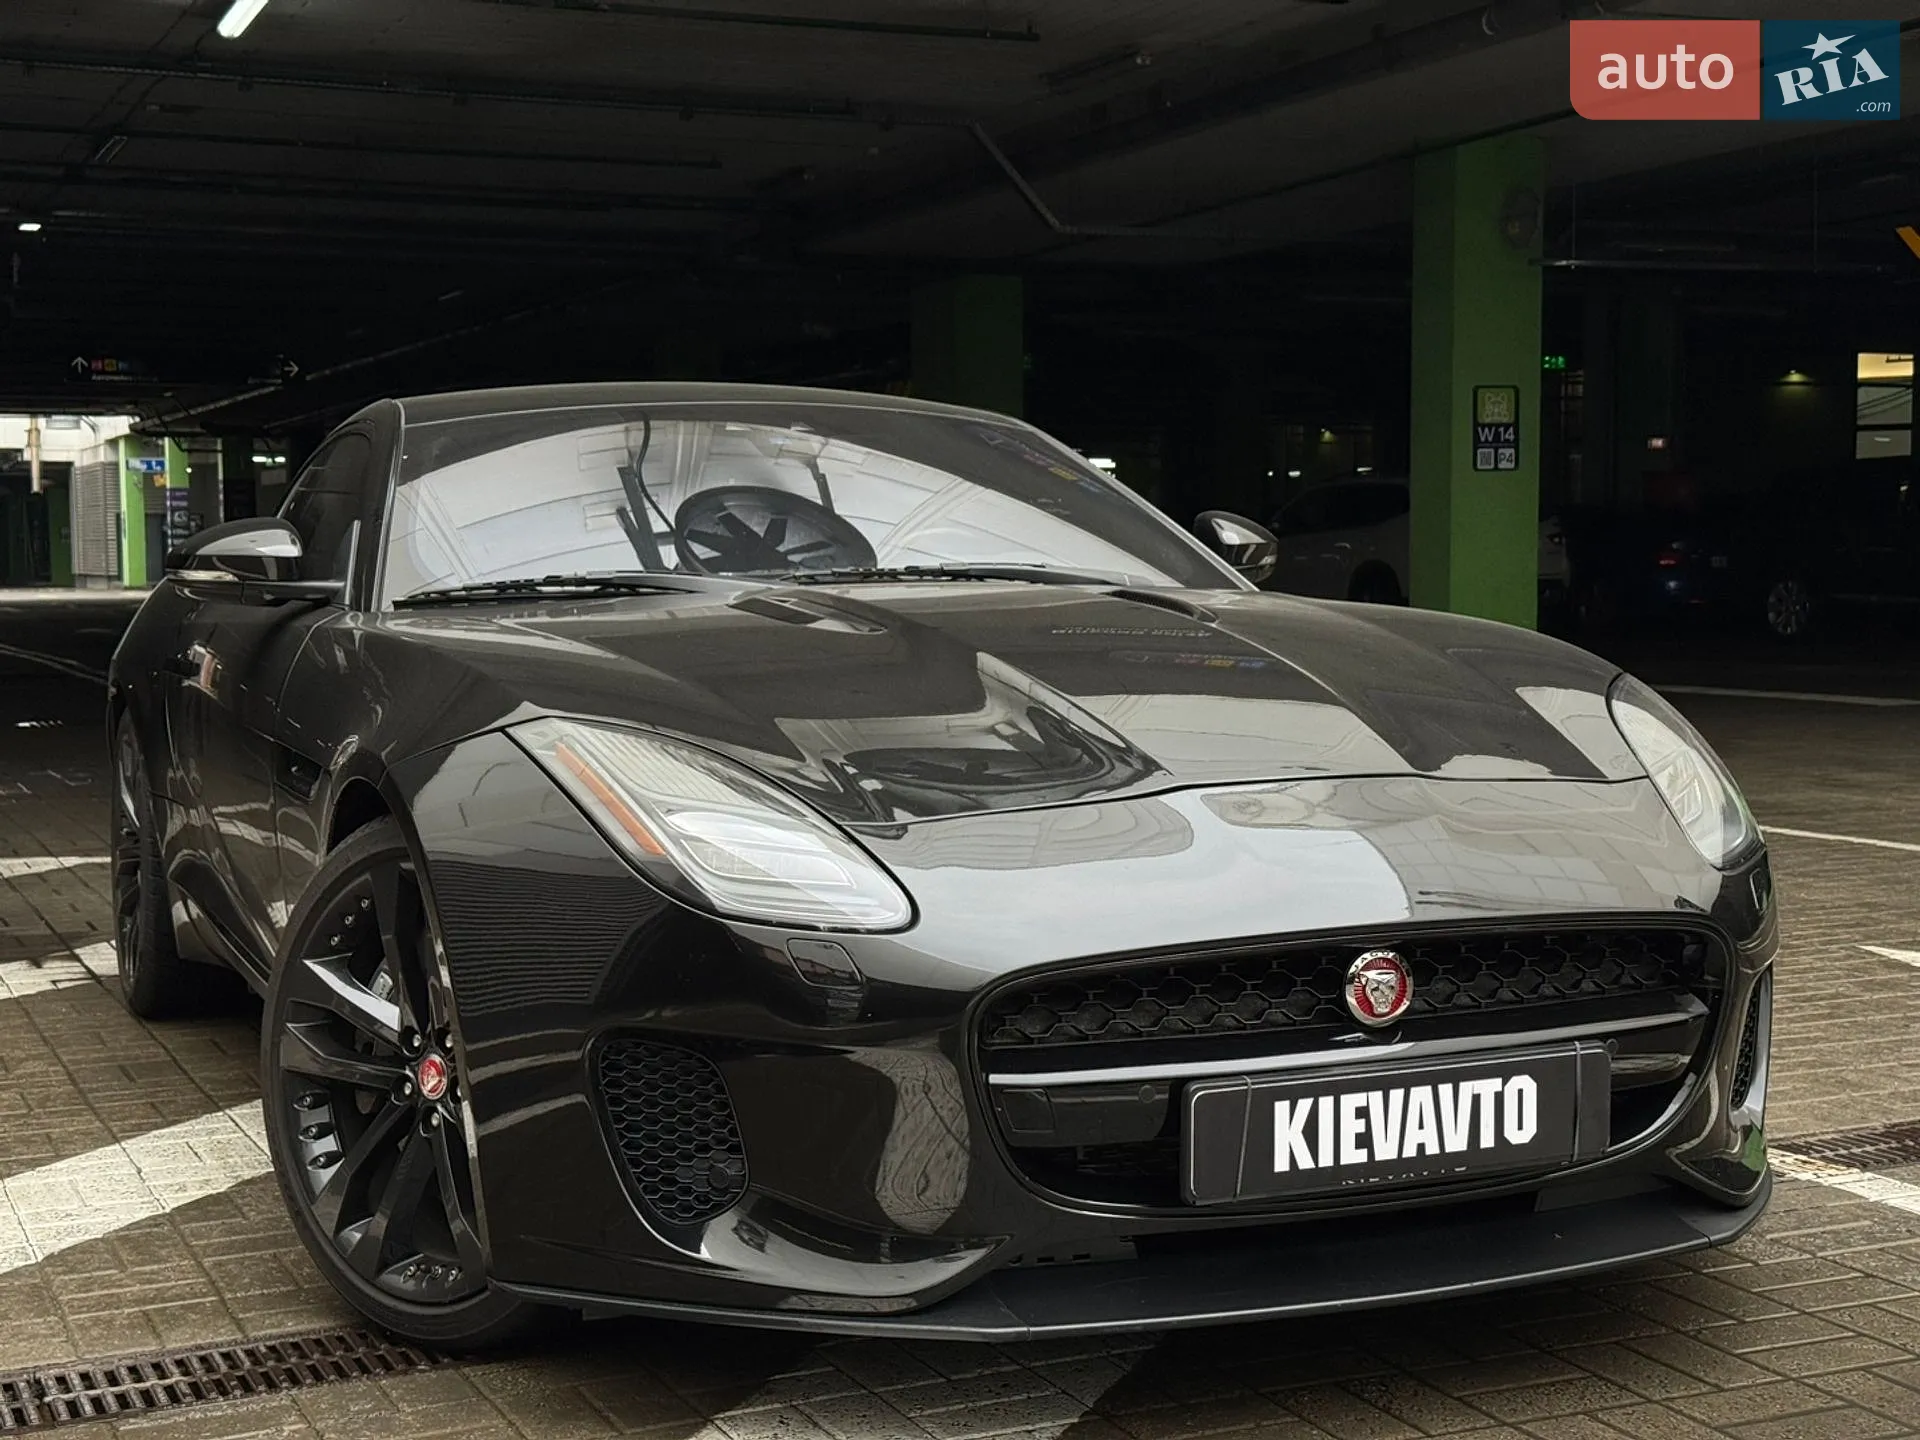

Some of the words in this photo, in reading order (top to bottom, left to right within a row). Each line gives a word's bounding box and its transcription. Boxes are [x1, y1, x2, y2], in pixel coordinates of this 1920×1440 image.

[1478, 427, 1496, 443] W
[1498, 426, 1515, 443] 14
[1273, 1074, 1538, 1174] KIEVAVTO
